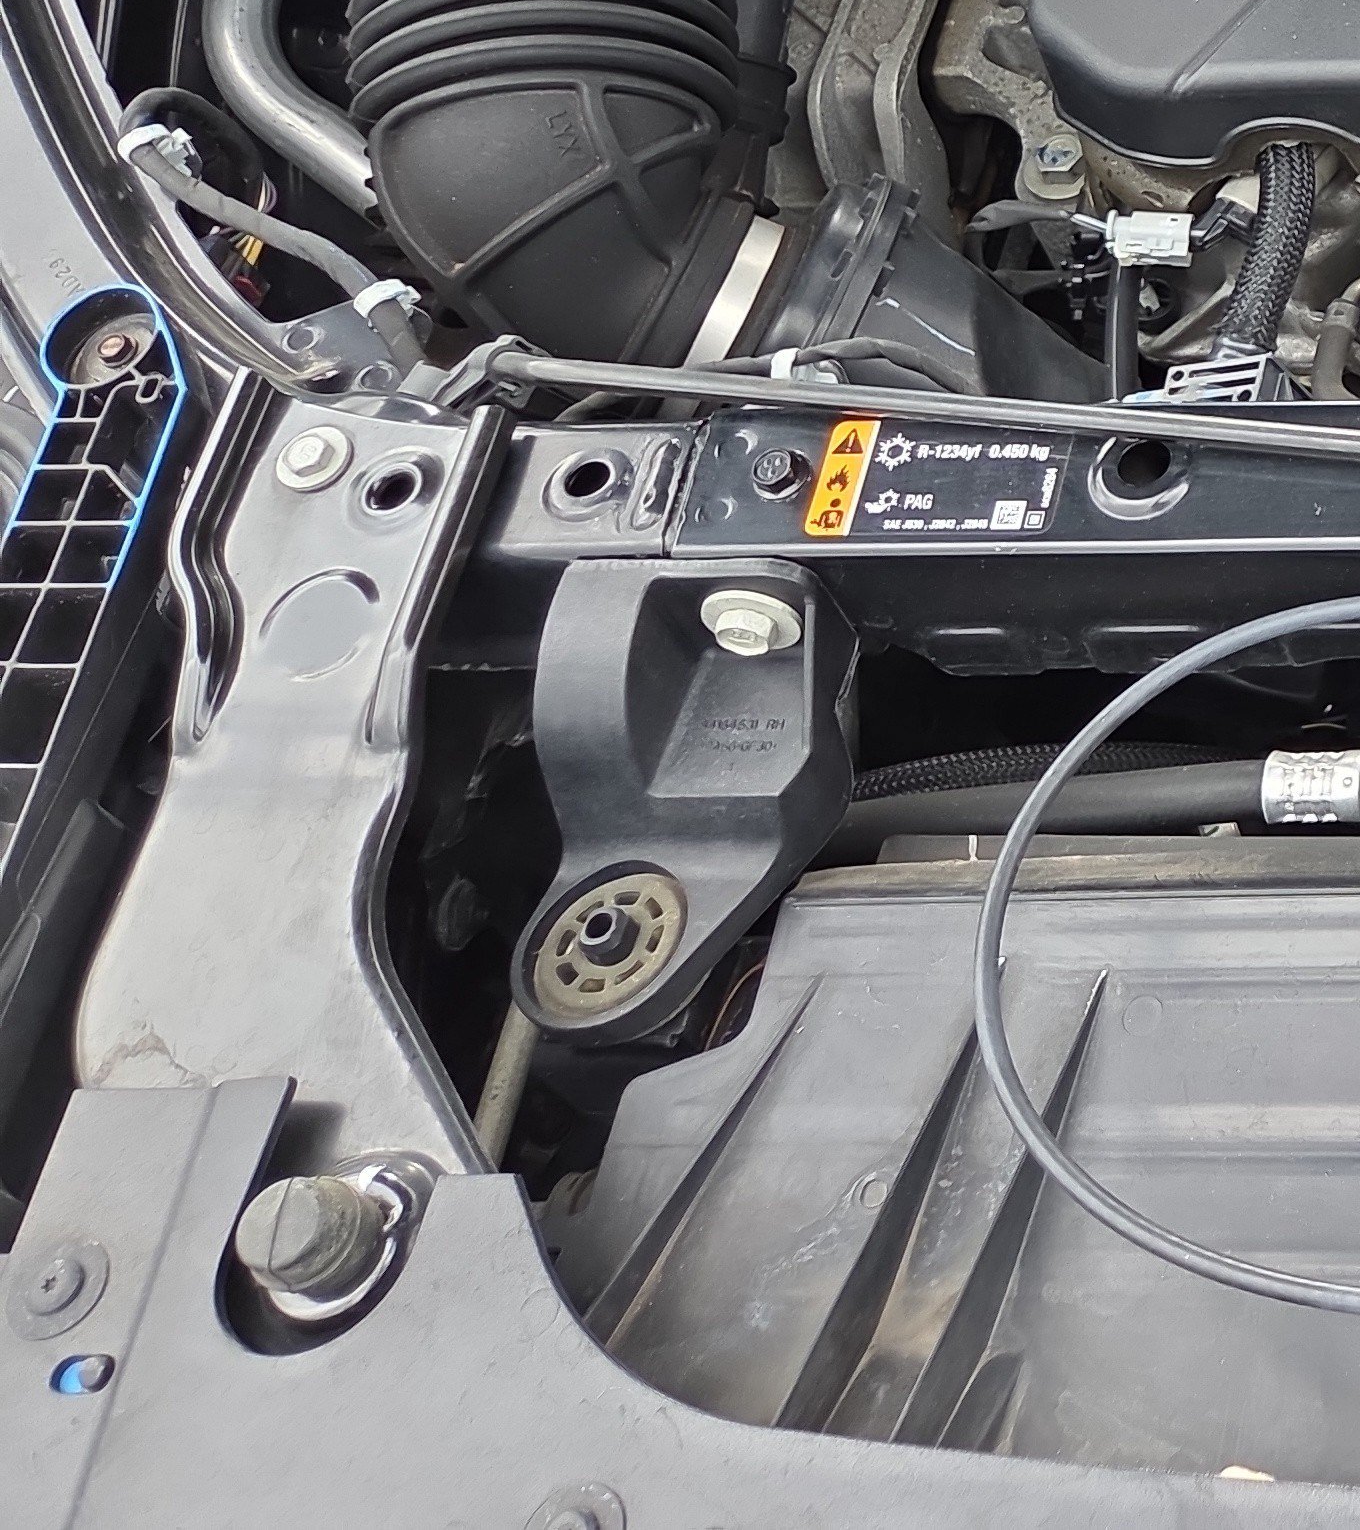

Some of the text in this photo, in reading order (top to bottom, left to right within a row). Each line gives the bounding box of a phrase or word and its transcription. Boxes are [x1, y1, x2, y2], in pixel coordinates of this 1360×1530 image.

[917, 444, 1051, 462] R-1234yf 0.450 kg
[904, 494, 934, 510] PAG
